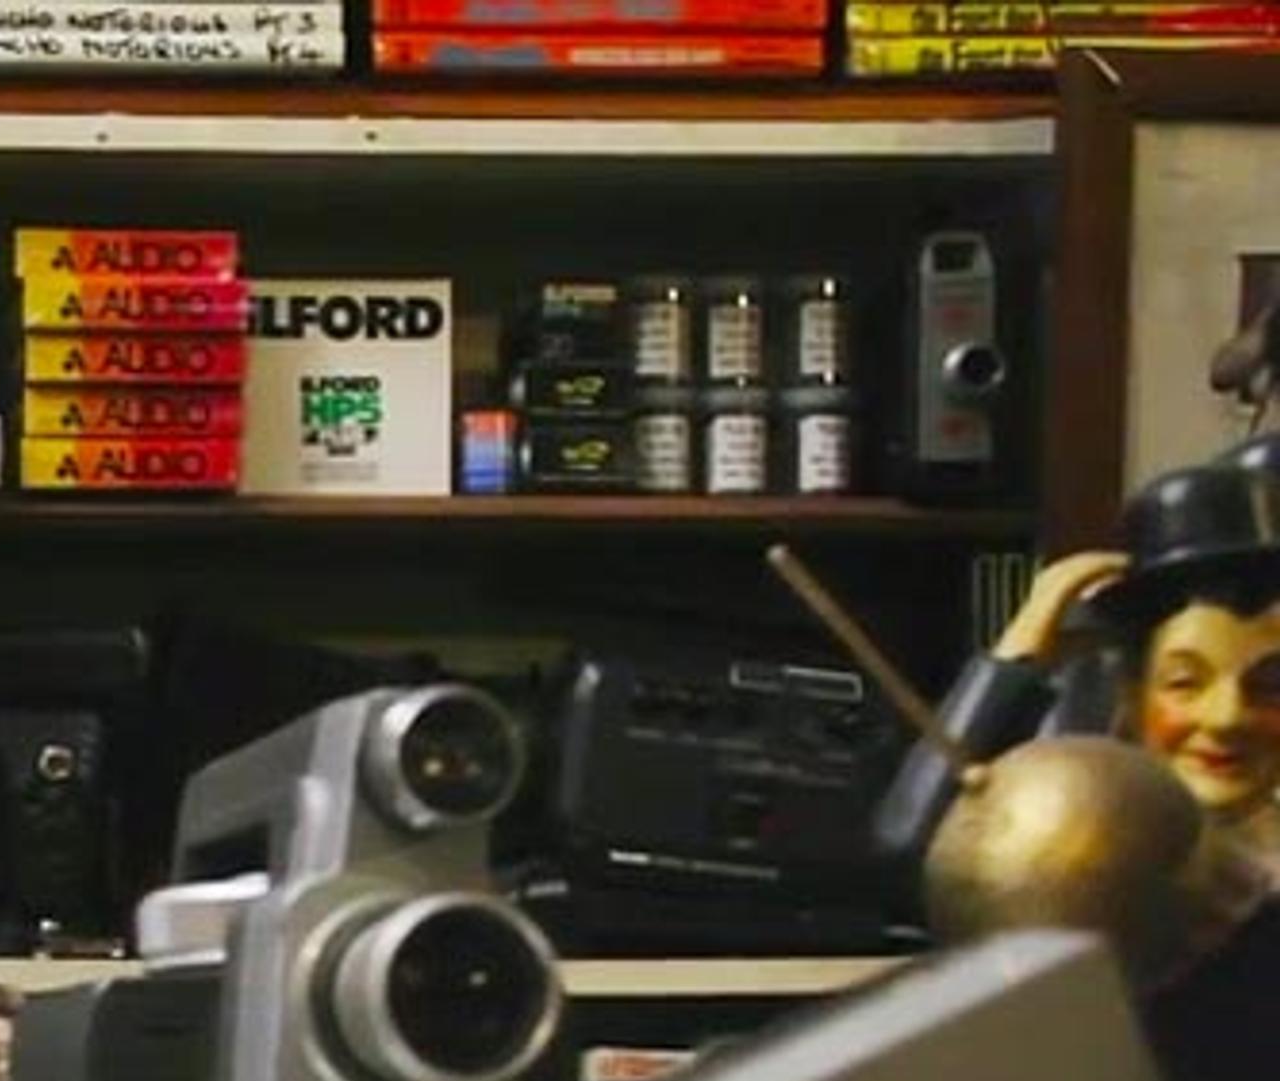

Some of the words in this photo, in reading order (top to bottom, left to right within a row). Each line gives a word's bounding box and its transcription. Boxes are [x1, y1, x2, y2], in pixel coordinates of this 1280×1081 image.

[89, 243, 203, 273] AUDIO
[100, 288, 211, 317] AUDIO
[105, 342, 215, 373] AUDIO
[101, 398, 210, 428] AUDIO
[94, 448, 207, 480] AUDIO
